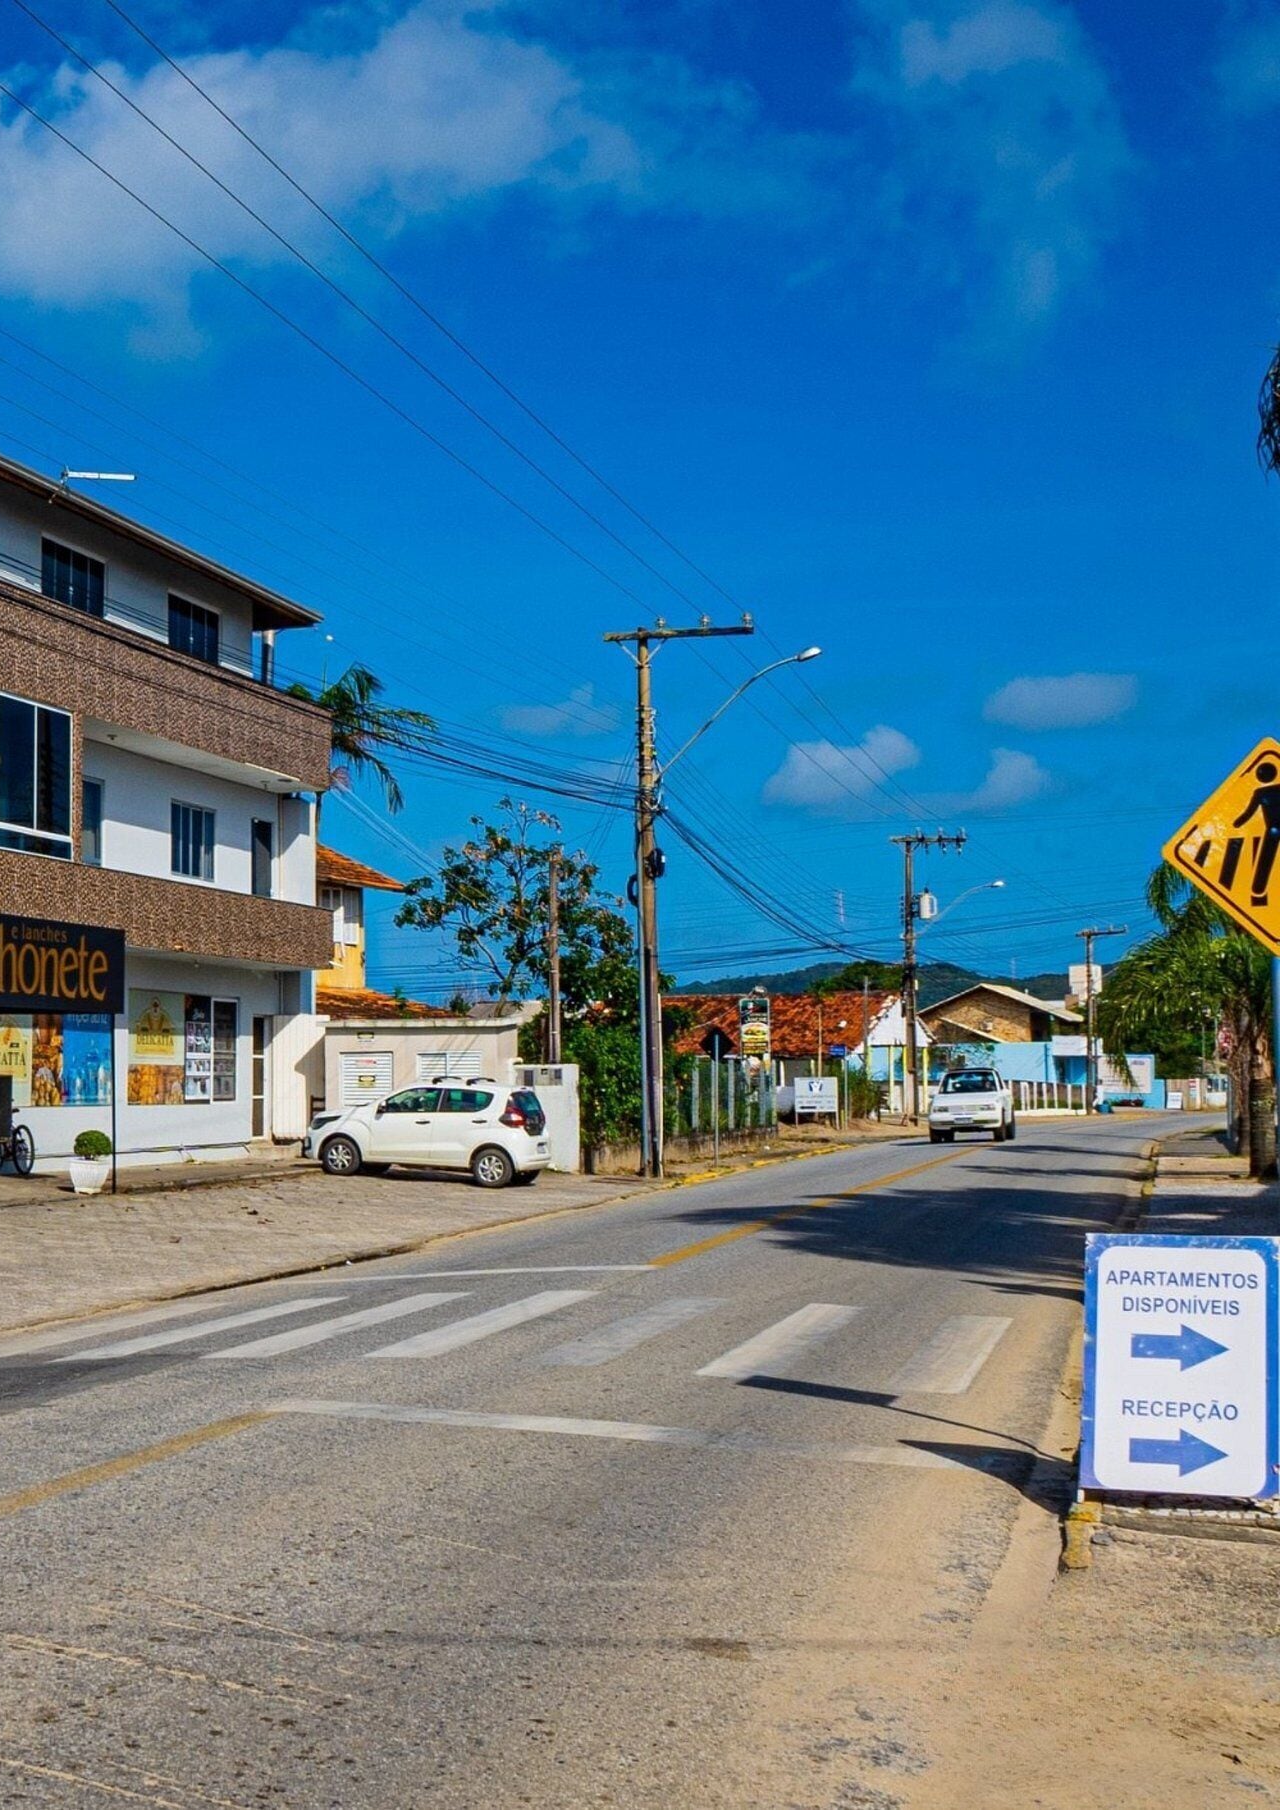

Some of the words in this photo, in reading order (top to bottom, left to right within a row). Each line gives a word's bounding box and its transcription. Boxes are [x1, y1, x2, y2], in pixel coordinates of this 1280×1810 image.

[11, 925, 19, 939] e
[22, 924, 67, 943] lanches
[136, 1032, 174, 1046] DELICATTA
[1106, 1270, 1258, 1289] APARTAMENTOS
[1122, 1295, 1240, 1316] DISPONÍVEIS
[1122, 1399, 1239, 1423] RECEPÇÃO
